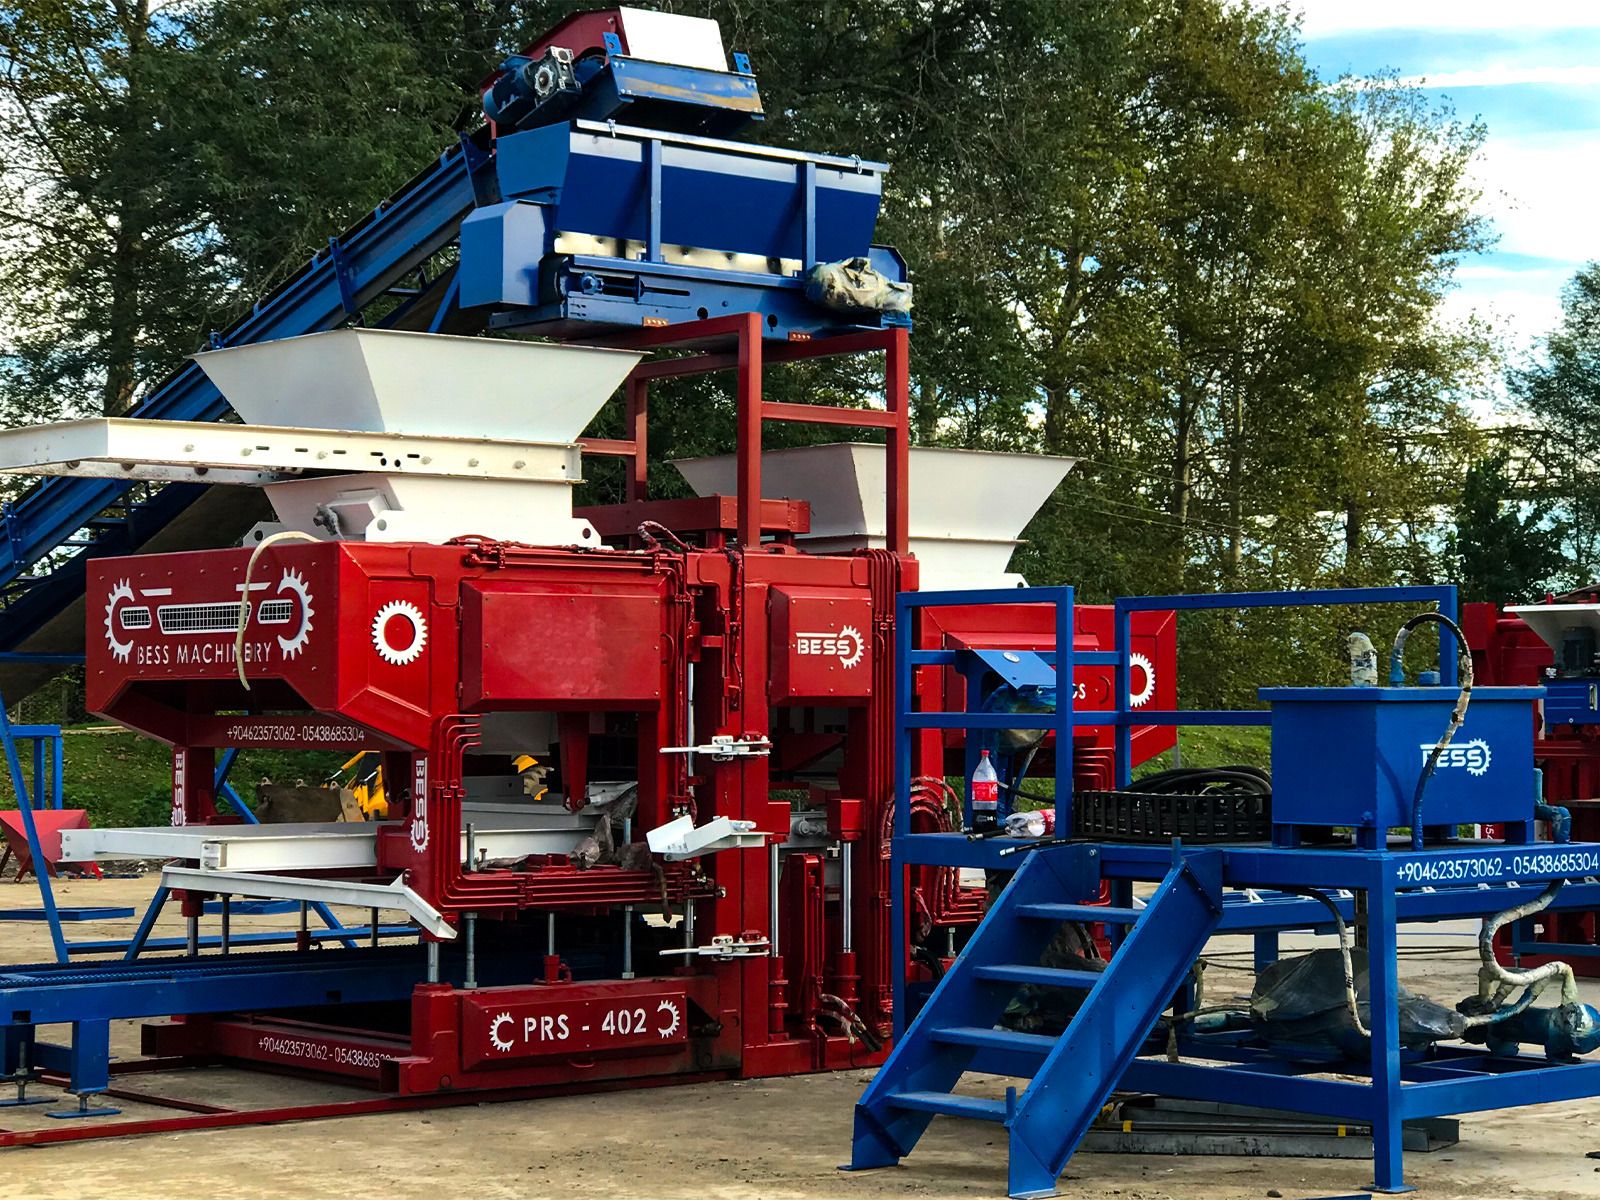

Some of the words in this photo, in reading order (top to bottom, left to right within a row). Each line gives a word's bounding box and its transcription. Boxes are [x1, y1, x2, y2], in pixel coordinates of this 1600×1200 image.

[137, 645, 169, 665] BESS
[797, 638, 850, 656] BESS
[227, 725, 295, 741] +904623573062
[175, 753, 183, 825] BESS
[415, 760, 425, 840] BESS
[1396, 857, 1503, 882] +904623573062
[1513, 852, 1599, 875] 05438685304
[524, 1014, 570, 1042] PRS
[601, 1008, 647, 1035] 402
[258, 1036, 328, 1060] +904623573062
